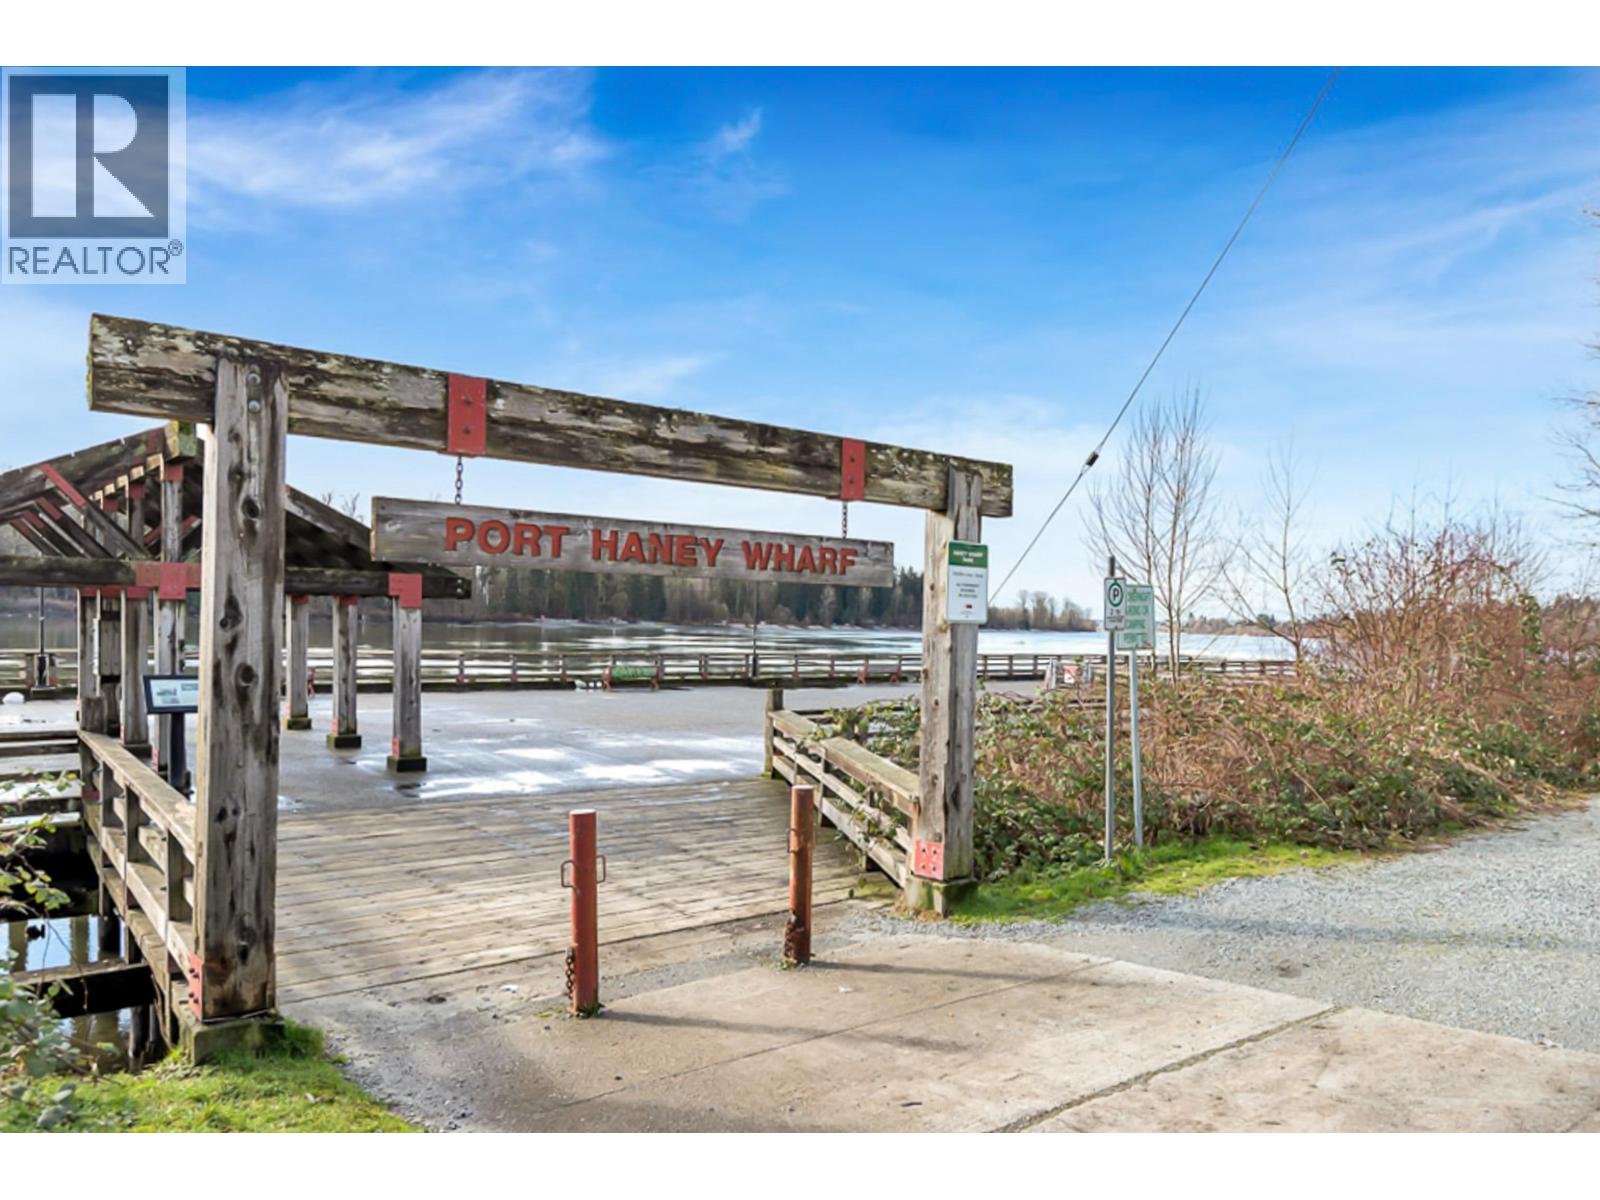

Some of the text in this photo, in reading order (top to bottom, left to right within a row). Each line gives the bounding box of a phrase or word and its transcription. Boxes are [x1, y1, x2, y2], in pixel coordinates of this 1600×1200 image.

[444, 516, 858, 575] PORT HANEY WHARF
